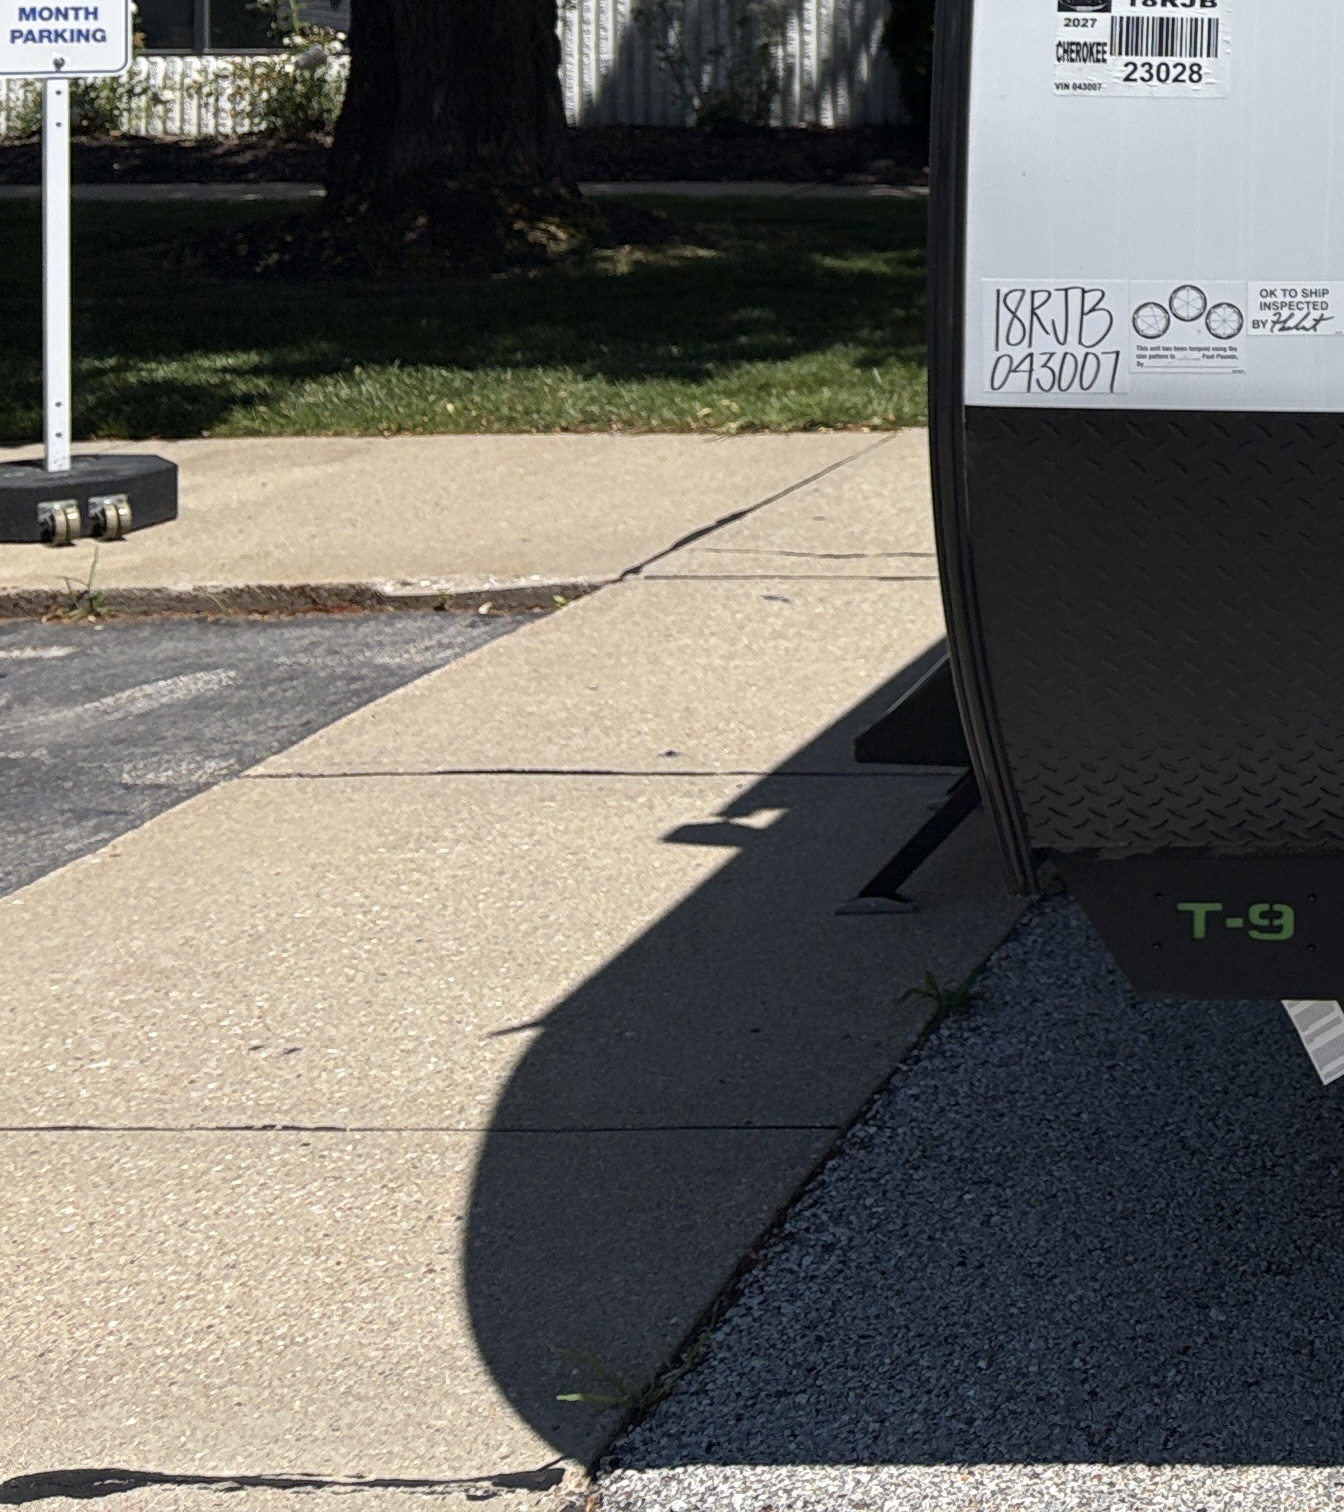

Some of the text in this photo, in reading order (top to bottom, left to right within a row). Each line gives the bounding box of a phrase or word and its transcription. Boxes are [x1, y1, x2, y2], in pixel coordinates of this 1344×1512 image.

[18, 6, 98, 22] MONTH
[1063, 17, 1098, 28] 2027
[10, 28, 107, 44] PARKING
[1055, 40, 1108, 64] CHEROKEE
[1122, 61, 1203, 84] 23028
[1259, 288, 1330, 299] OK TO SHIP
[1259, 301, 1329, 312] INSPECTED
[994, 286, 1114, 352] 18RJB
[1252, 319, 1269, 330] BY
[990, 349, 1121, 394] 043007
[1176, 902, 1295, 941] T-9
